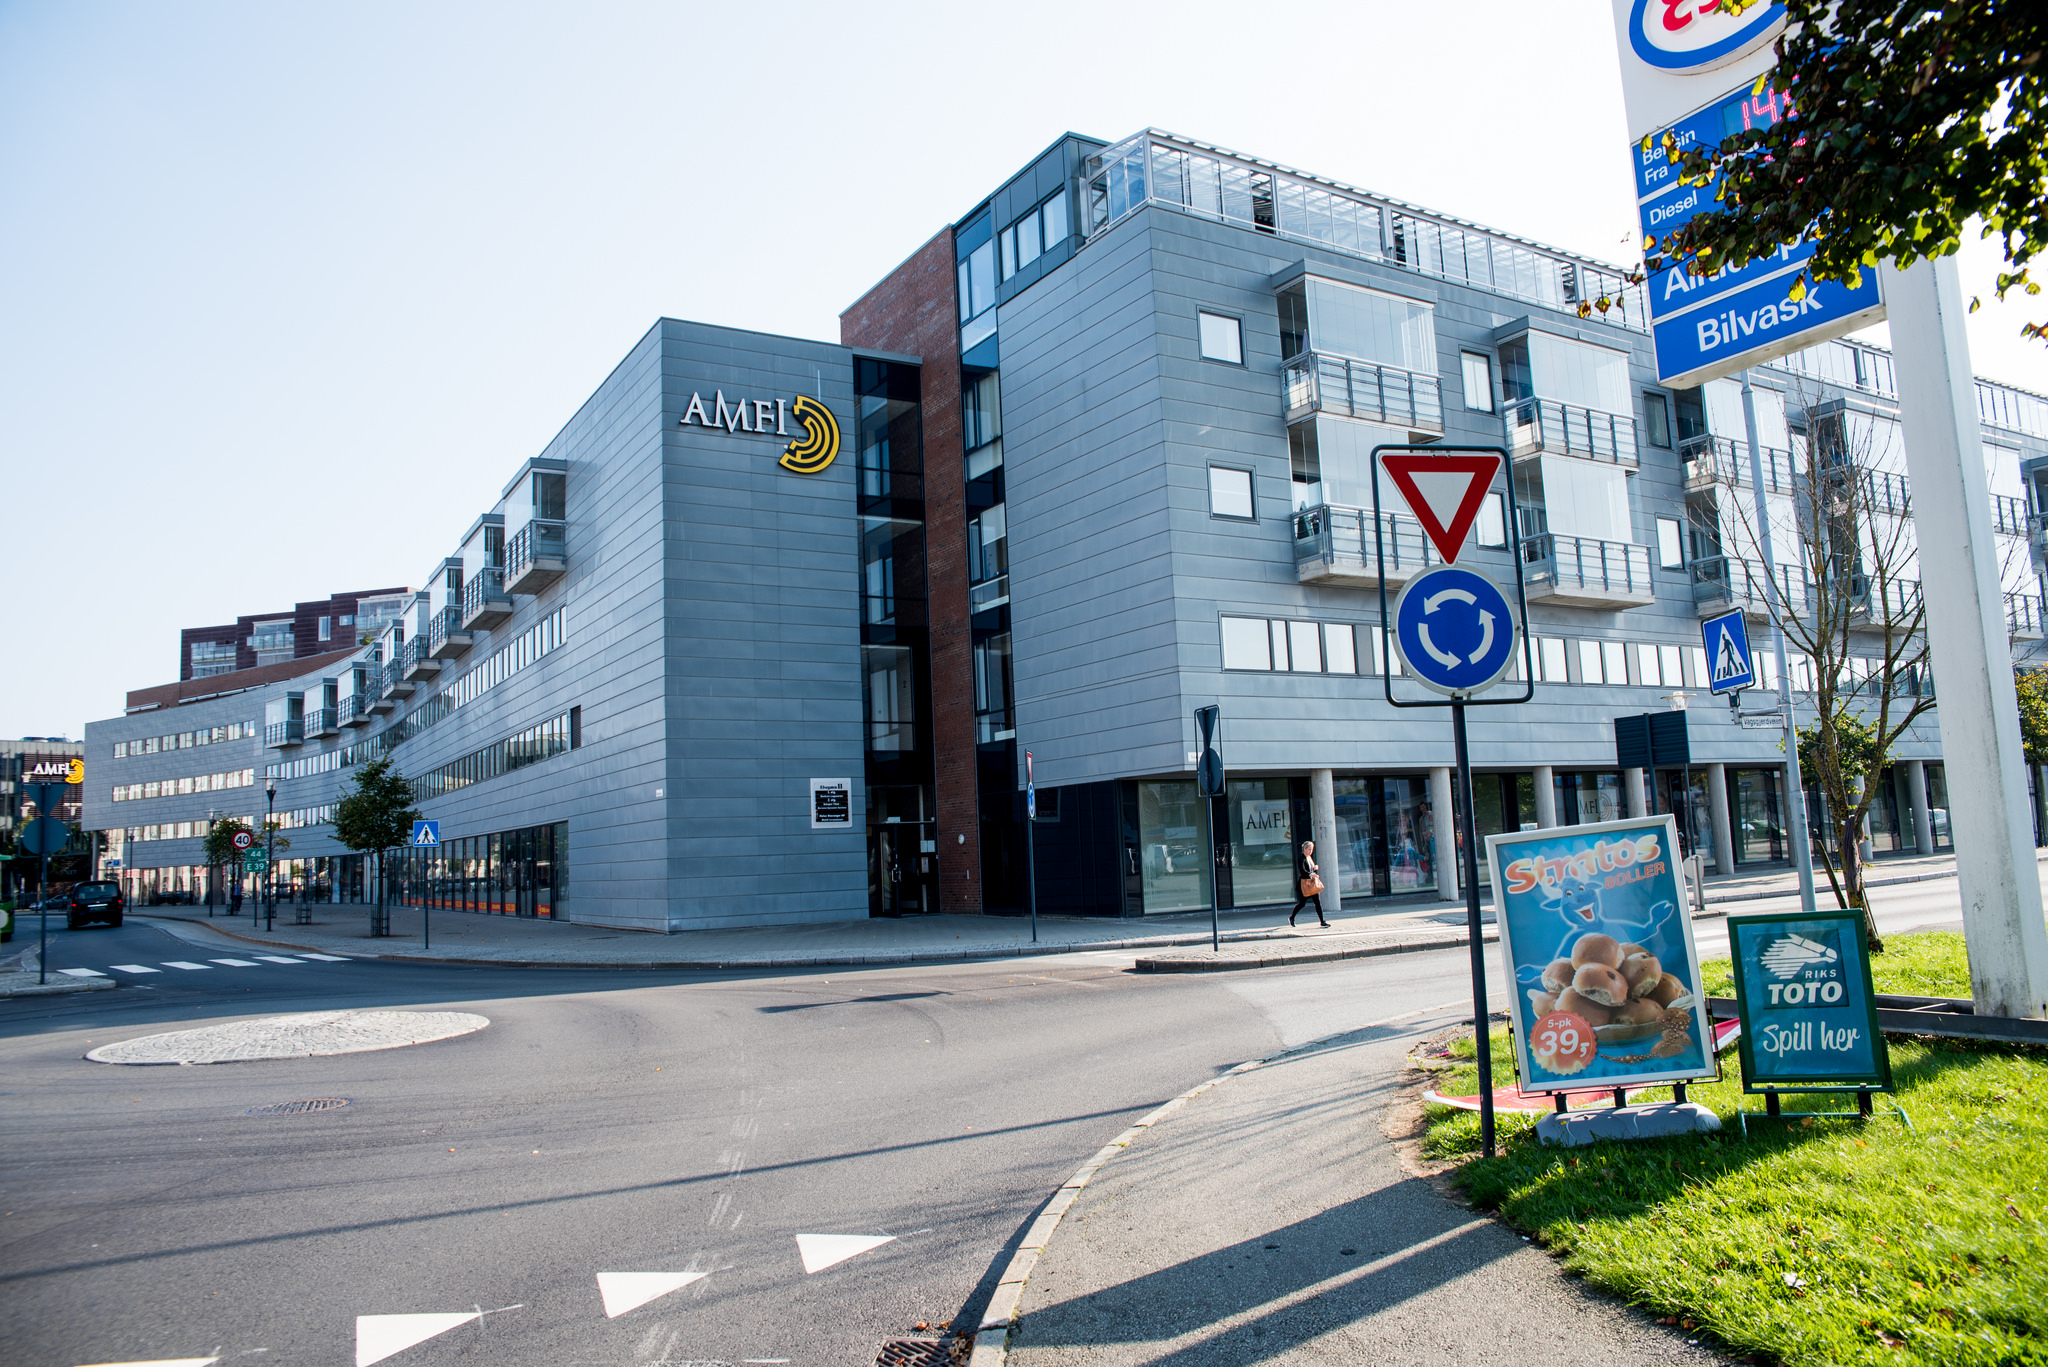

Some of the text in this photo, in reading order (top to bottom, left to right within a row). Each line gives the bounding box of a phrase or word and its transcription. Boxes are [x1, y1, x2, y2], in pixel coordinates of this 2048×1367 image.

[1644, 165, 1669, 186] Fra
[1649, 189, 1698, 226] Diesel
[1696, 284, 1824, 353] Bilvask
[679, 388, 788, 435] AMFI
[33, 761, 70, 776] AMFI
[1579, 798, 1600, 816] MFI
[1245, 809, 1287, 830] AMFI
[235, 836, 249, 844] 40
[1505, 834, 1661, 895] Stratos
[1604, 861, 1666, 890] BOLLER
[1804, 968, 1837, 979] RIKS
[1767, 980, 1843, 1005] TOTO
[1547, 1017, 1572, 1029] 5-pk
[1762, 1020, 1861, 1058] Spill her
